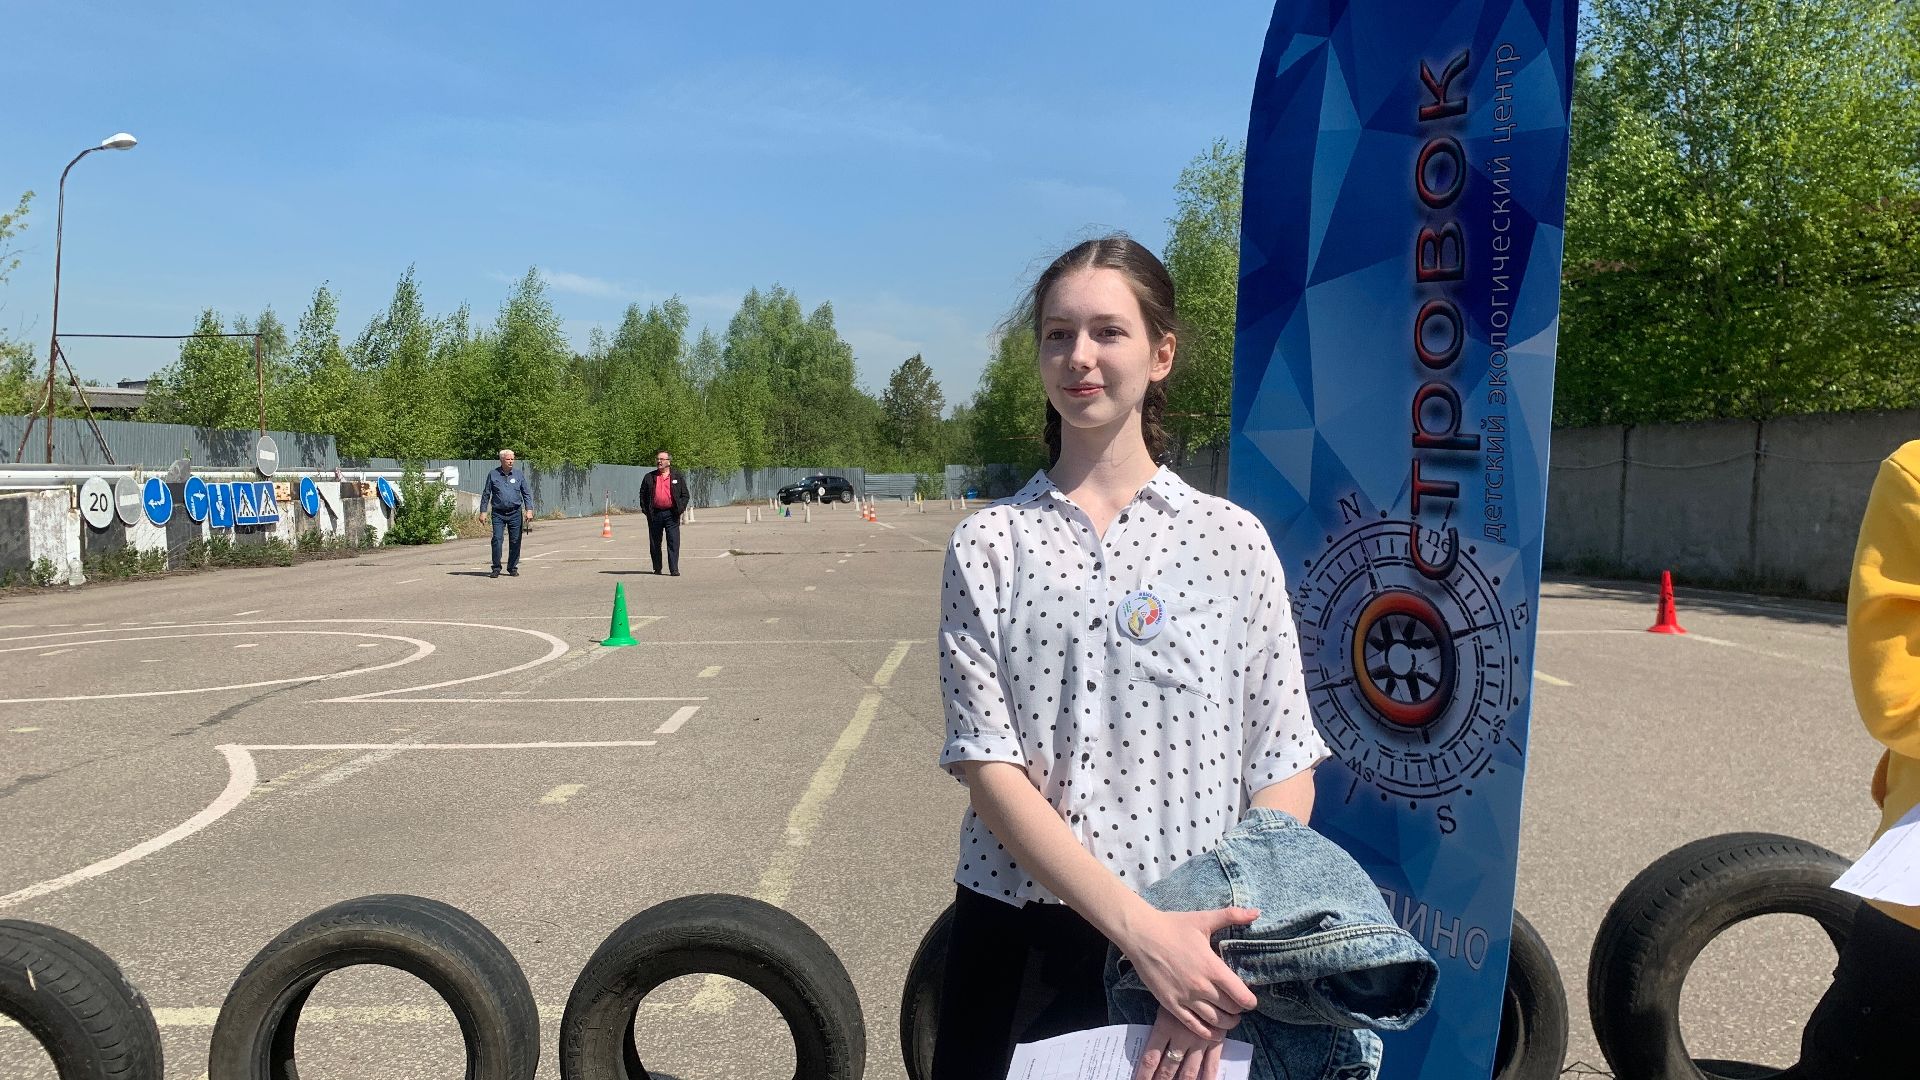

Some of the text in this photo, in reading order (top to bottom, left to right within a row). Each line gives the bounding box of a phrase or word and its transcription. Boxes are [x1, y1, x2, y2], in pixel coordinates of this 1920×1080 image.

[1480, 43, 1521, 544] детский экологический центр
[89, 492, 108, 512] 20
[1337, 491, 1362, 525] N
[1436, 805, 1457, 835] S
